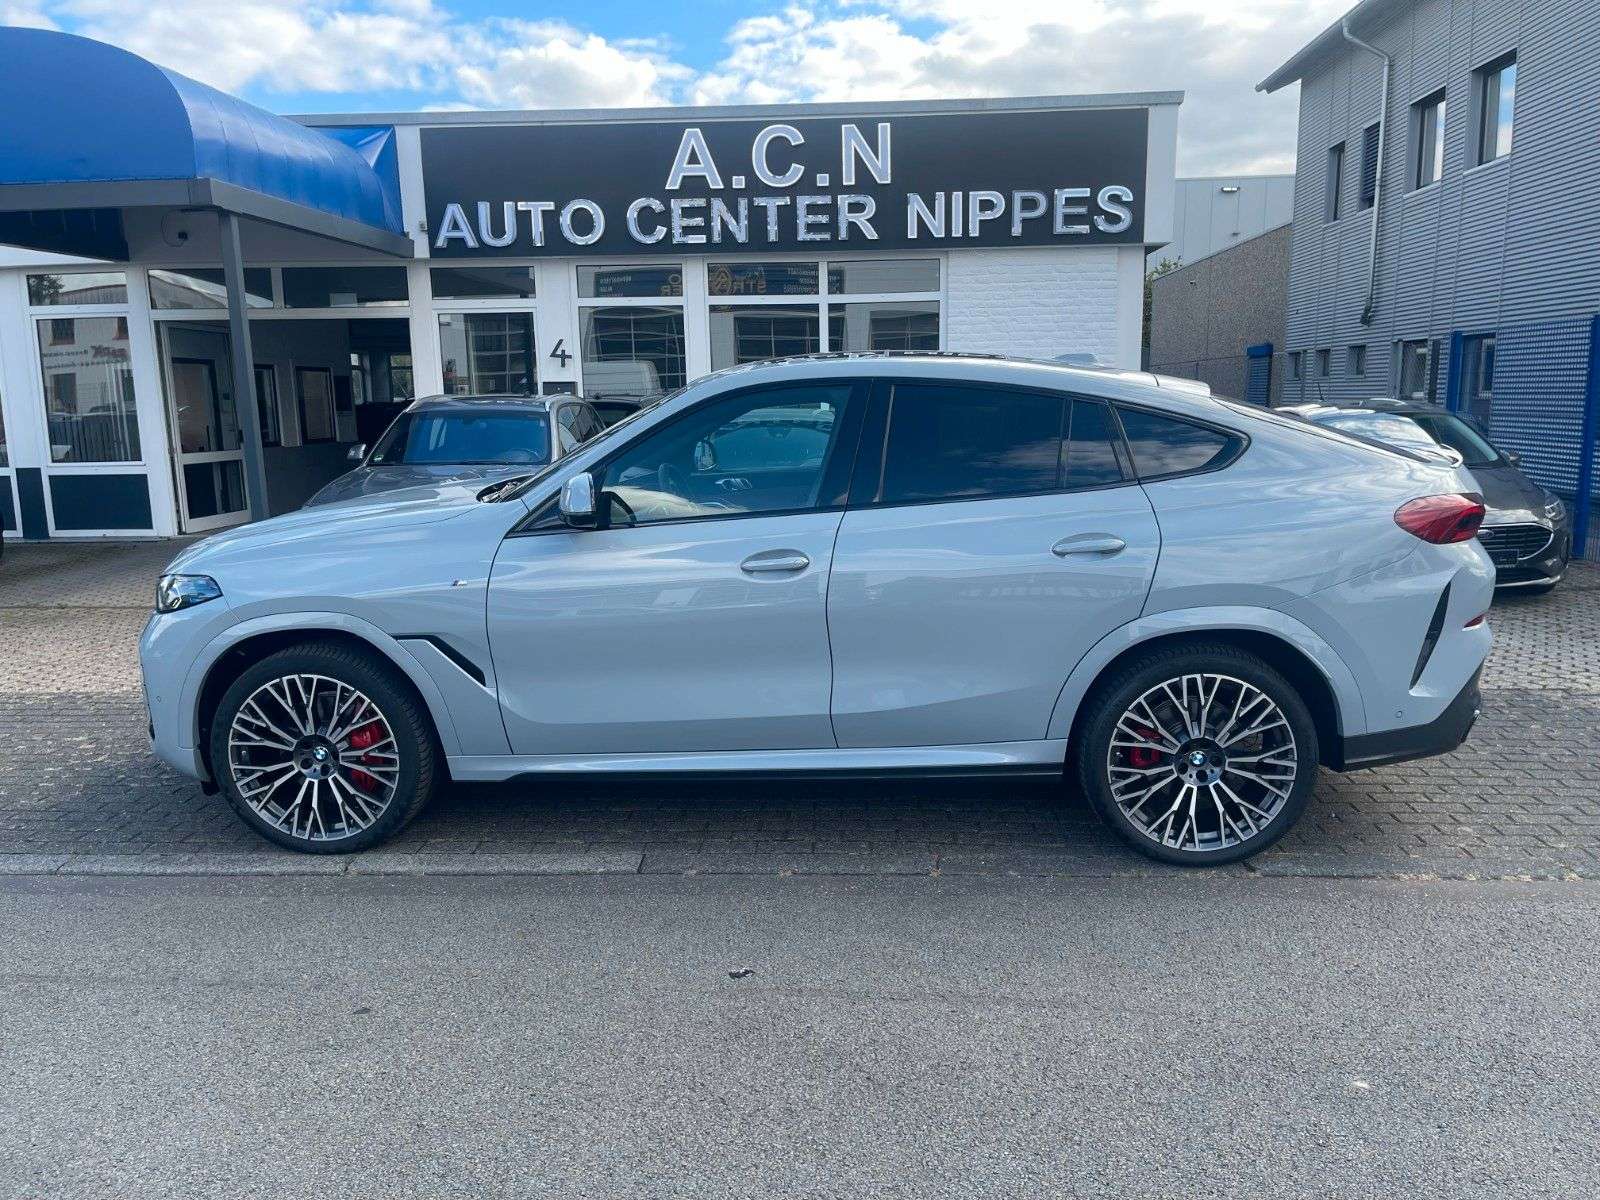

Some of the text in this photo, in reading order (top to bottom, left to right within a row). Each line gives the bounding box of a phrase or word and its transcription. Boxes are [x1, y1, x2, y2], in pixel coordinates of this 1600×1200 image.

[665, 122, 892, 190] A.C.N
[433, 185, 1134, 248] AUTO CENTER NIPPES
[549, 338, 573, 368] 4
